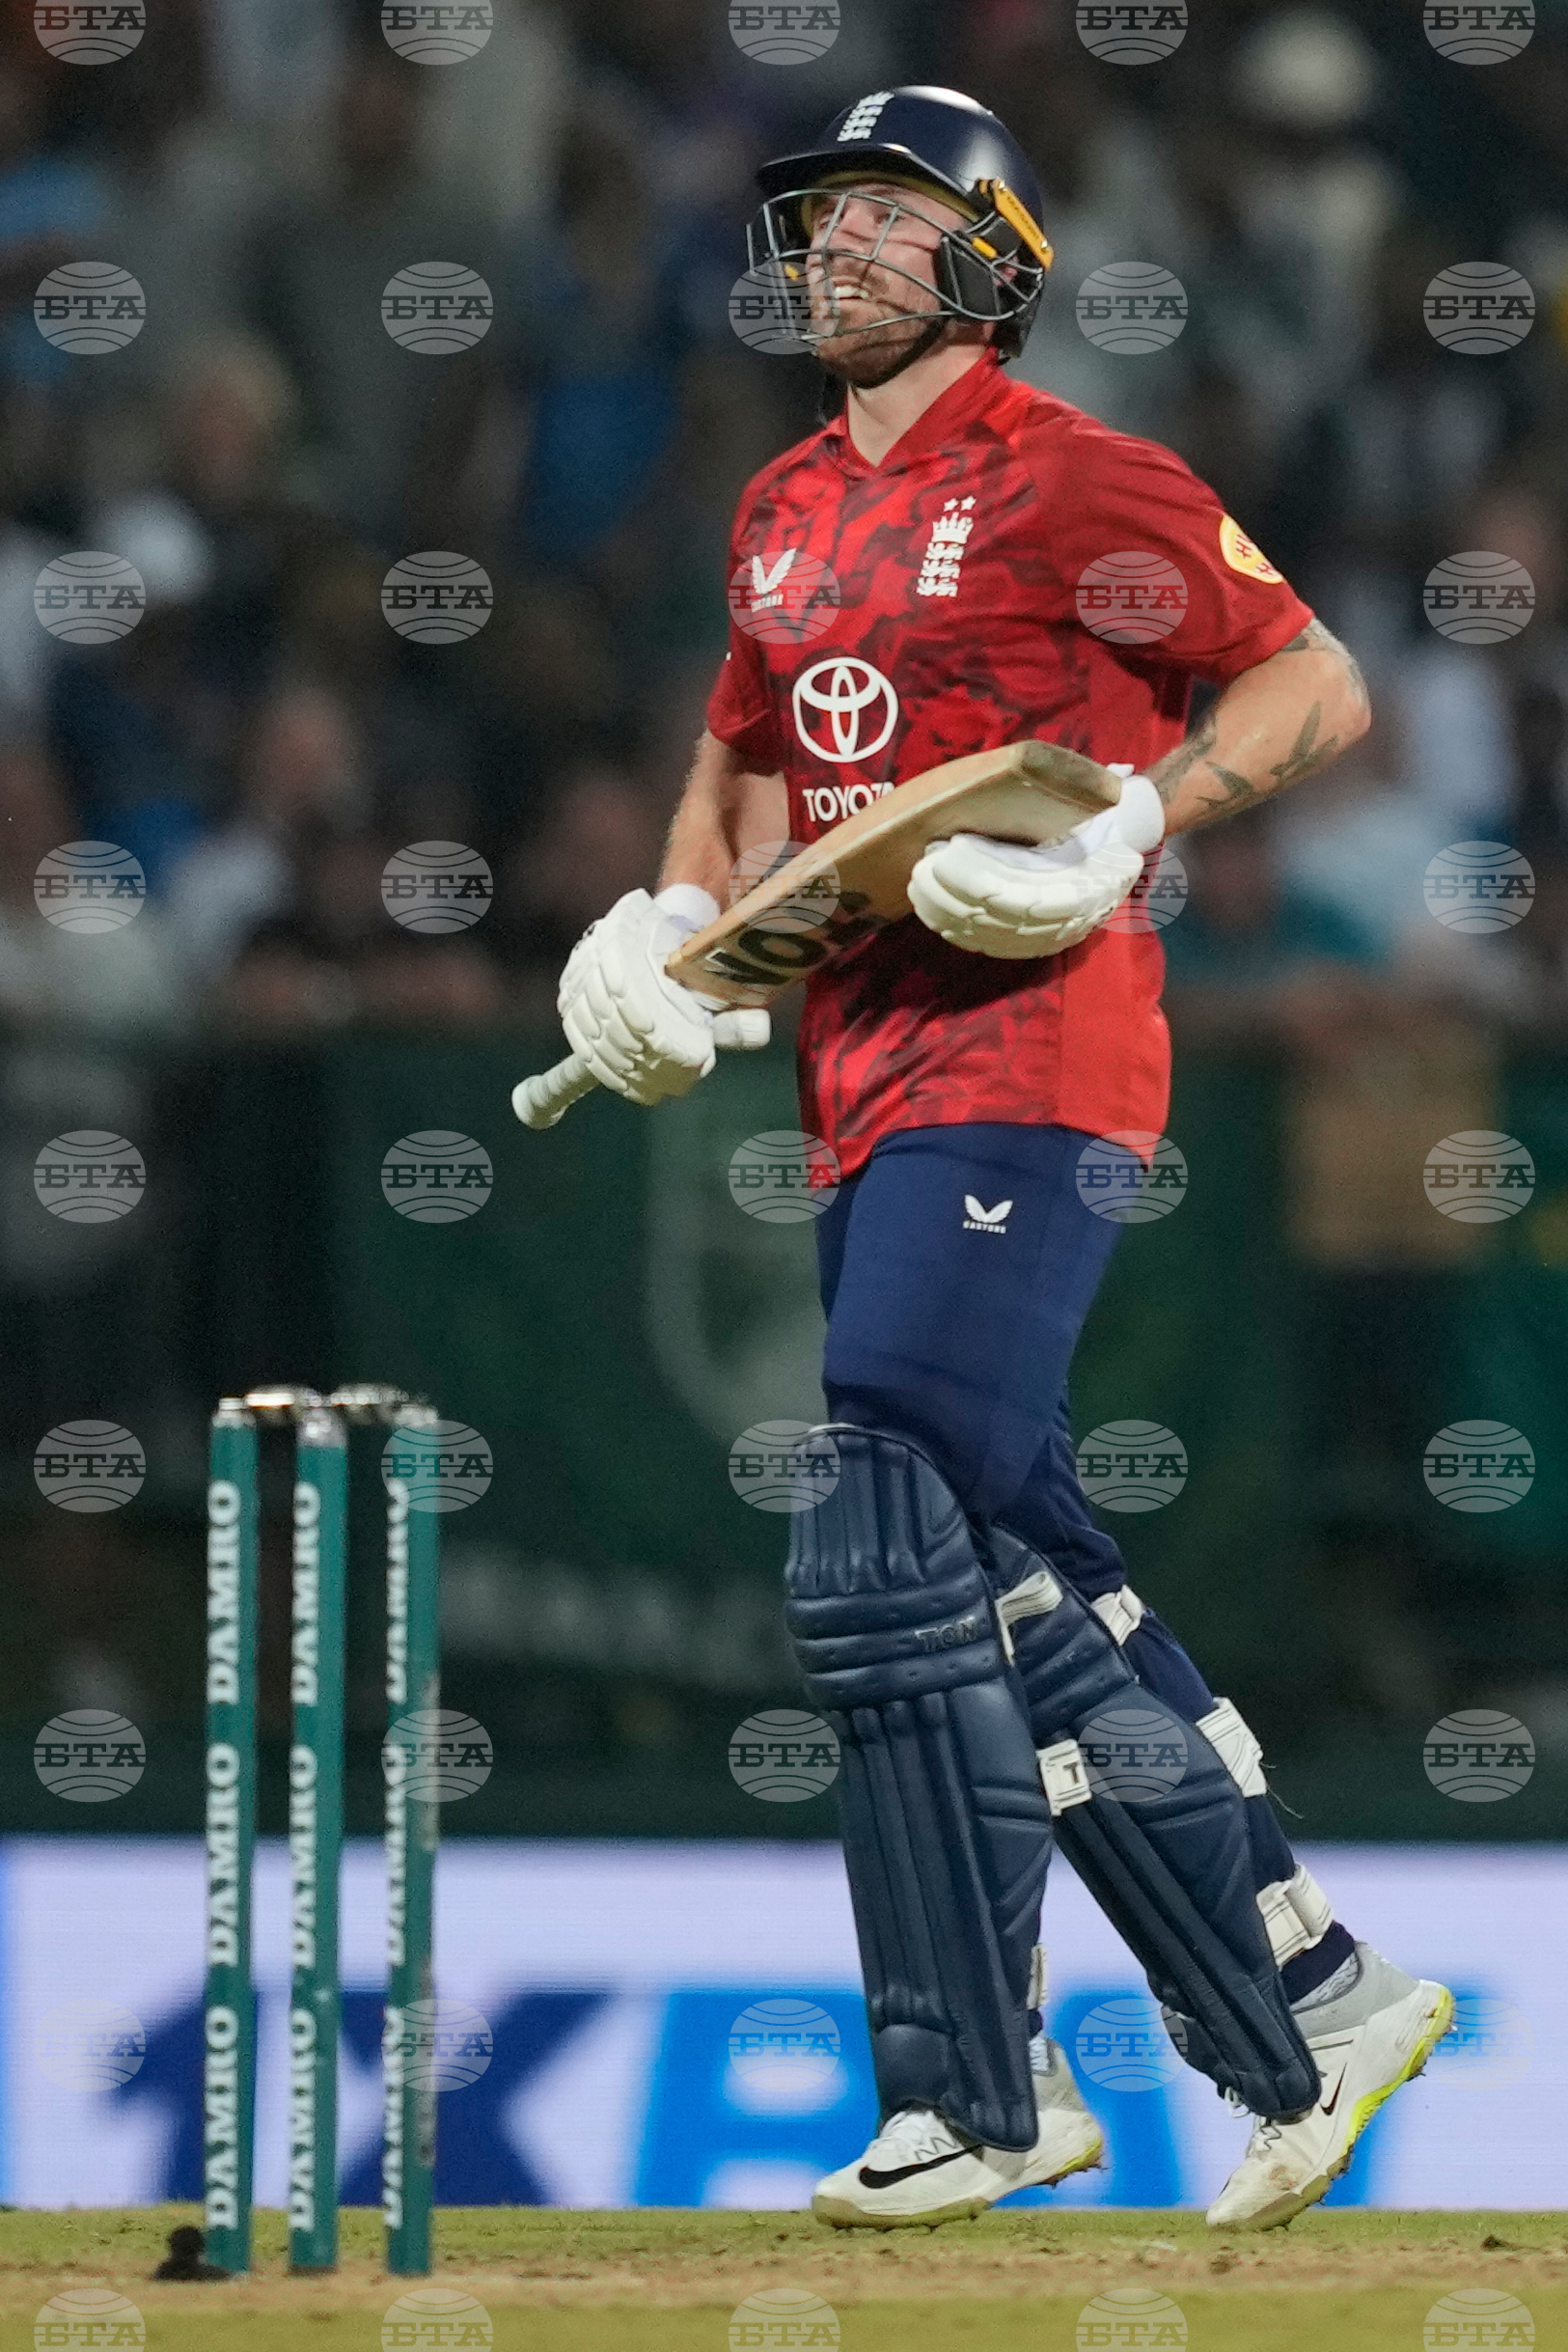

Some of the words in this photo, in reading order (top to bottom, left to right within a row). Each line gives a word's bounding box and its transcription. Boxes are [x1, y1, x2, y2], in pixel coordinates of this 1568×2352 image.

[206, 1480, 240, 1703] DAMRO
[291, 1480, 321, 1706] DAMRO
[206, 1742, 240, 1968] DAMRO
[290, 1744, 317, 1970] DAMRO
[205, 2005, 239, 2229] DAMRO
[290, 2007, 317, 2232] DAMRO
